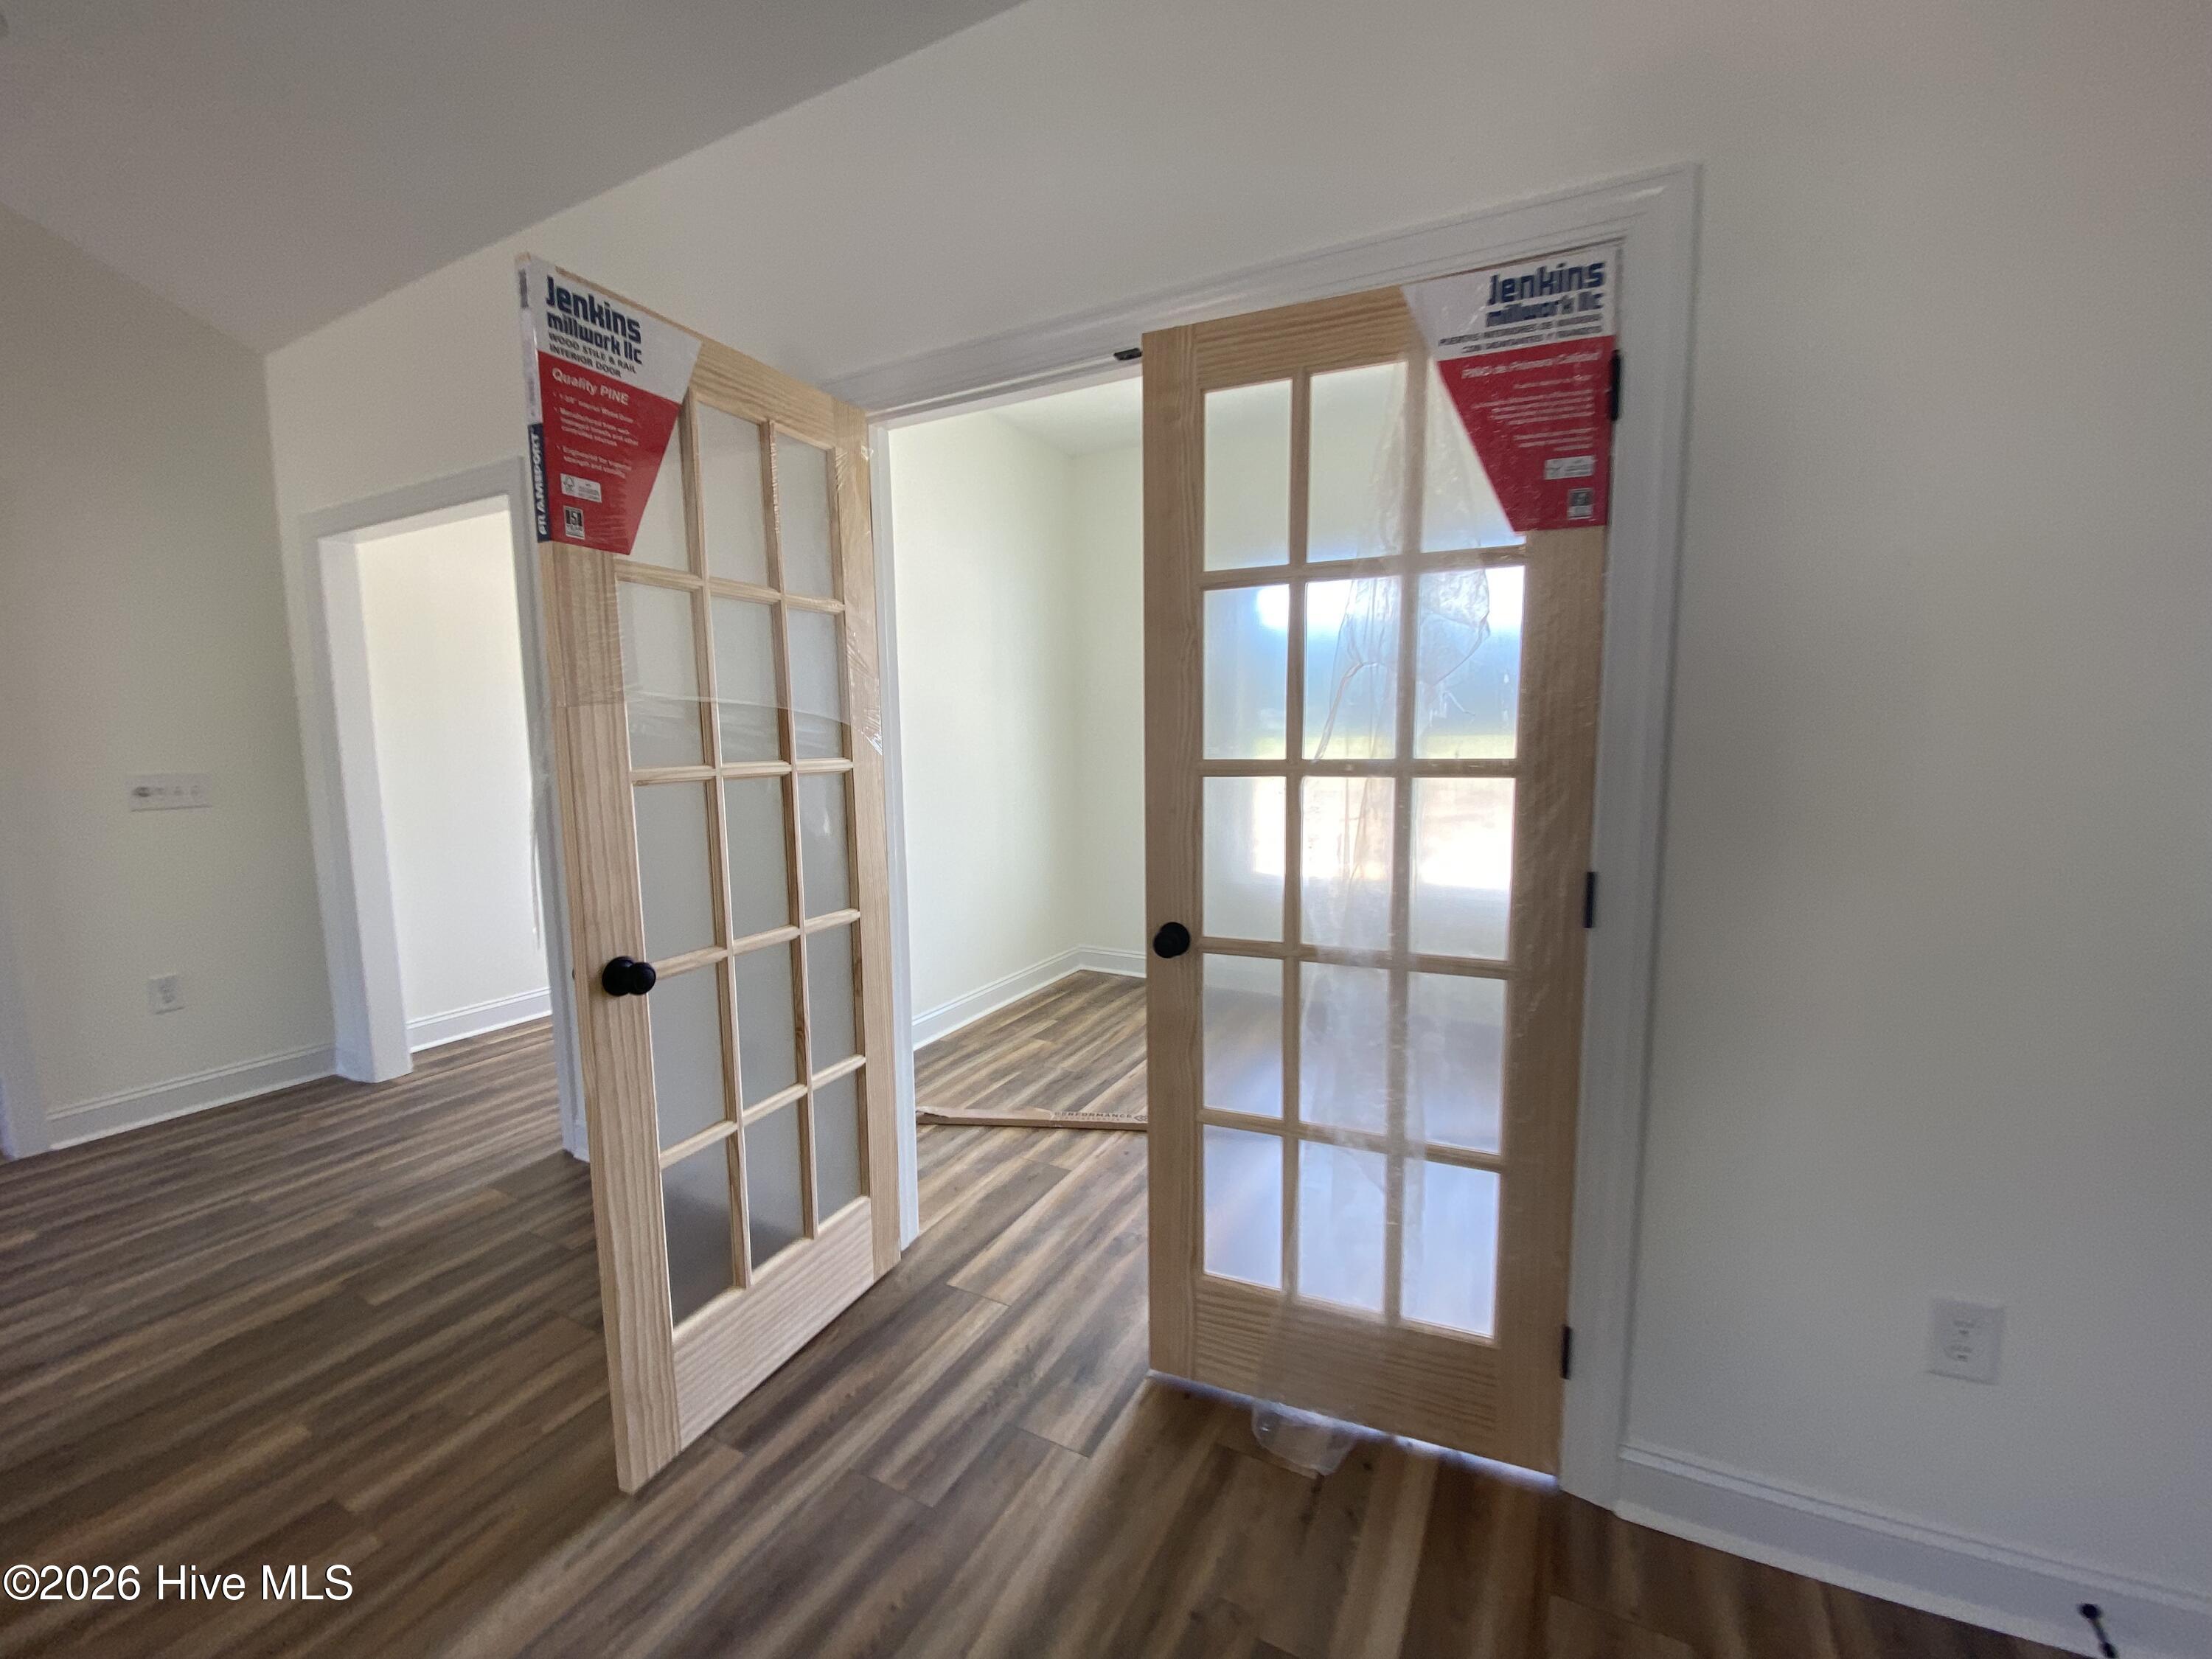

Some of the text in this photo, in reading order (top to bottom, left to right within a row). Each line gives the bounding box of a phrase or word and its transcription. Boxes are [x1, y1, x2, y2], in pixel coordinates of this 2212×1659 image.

[1487, 262, 1606, 306] Jenkins
[546, 274, 641, 344] Jenkins
[547, 311, 643, 365] millwork llc
[549, 332, 580, 352] WOOD
[582, 346, 607, 361] STILE
[618, 358, 636, 374] RAIL
[549, 344, 622, 378] INTERIOR DOOR
[552, 367, 597, 397] Quality
[600, 384, 630, 406] PINE
